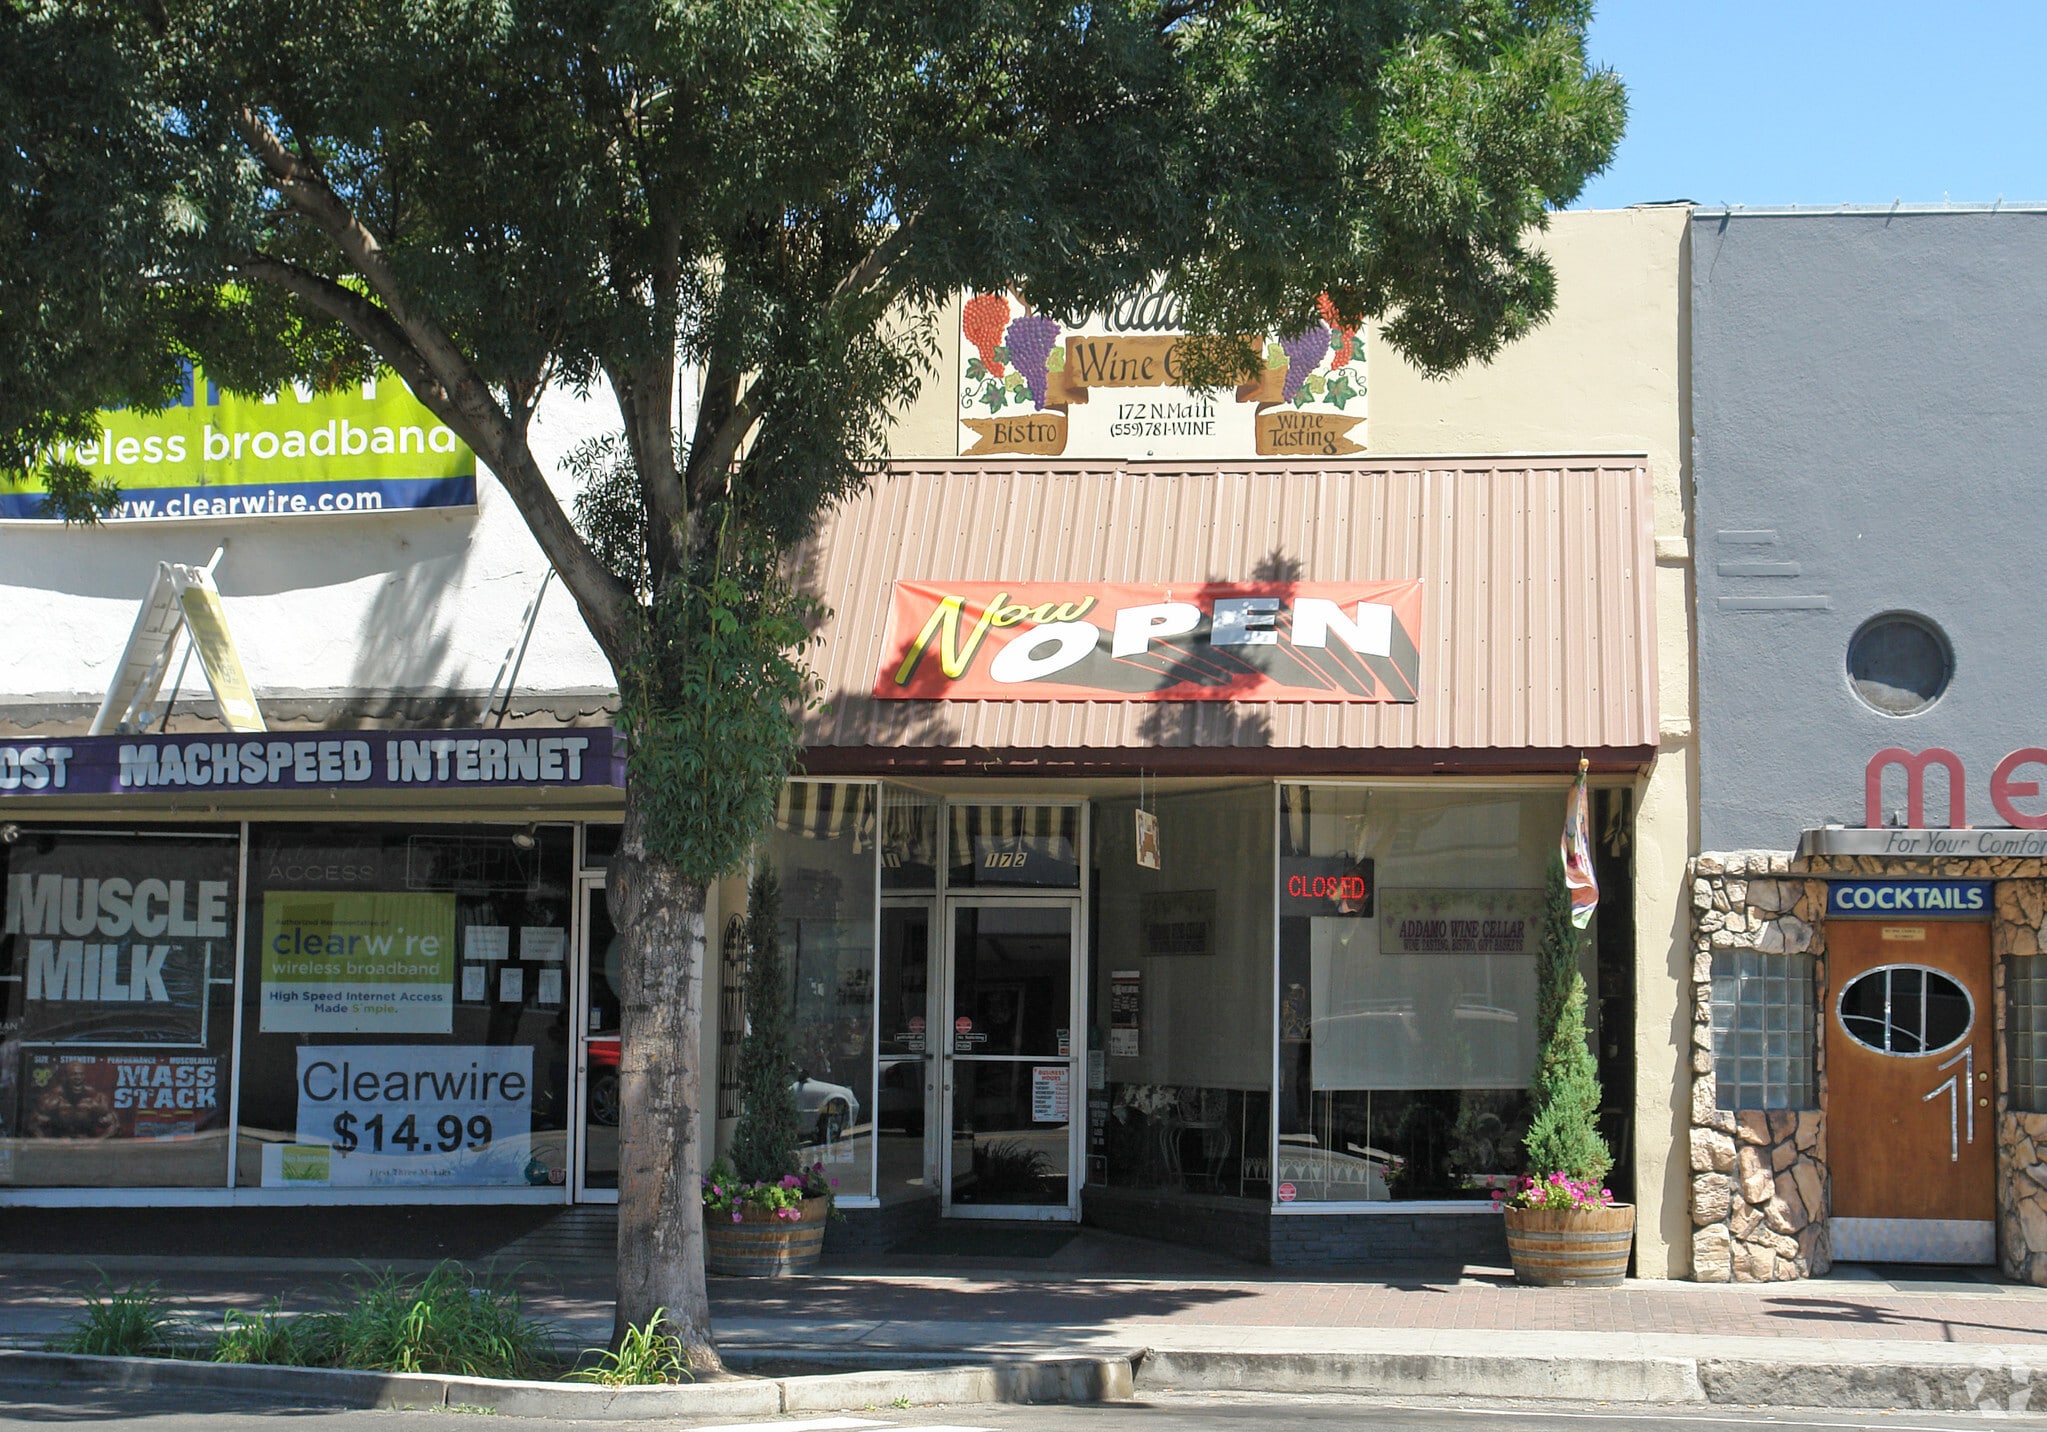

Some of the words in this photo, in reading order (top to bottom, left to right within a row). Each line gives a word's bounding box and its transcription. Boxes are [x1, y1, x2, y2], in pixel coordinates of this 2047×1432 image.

[1074, 342, 1154, 382] Wine
[1118, 403, 1147, 420] 172
[993, 422, 1058, 446] Bistro
[1268, 428, 1337, 455] Tasting
[92, 488, 383, 520] ww.clearwire.com
[895, 592, 1099, 686] Now
[988, 597, 1394, 684] OPEN
[119, 741, 373, 788] MACHSPEED
[387, 738, 590, 783] INTERNET
[1885, 831, 1920, 853] For
[1923, 831, 1970, 853] Your
[986, 852, 1027, 867] 172
[267, 864, 376, 882] ACCESS
[1288, 875, 1366, 899] CLOSED
[1835, 887, 1984, 910] COCKTAILS
[5, 874, 229, 937] MUSCLE
[1399, 919, 1447, 939] ADDAMO
[1450, 919, 1479, 938] WINE
[1482, 919, 1525, 938] CELLAR
[26, 939, 171, 1001] MILK
[271, 960, 341, 976] wireless
[346, 960, 440, 976] broadband
[269, 991, 299, 1004] High
[302, 991, 342, 1005] Speed
[346, 991, 396, 1002] Internet
[400, 991, 443, 1002] Access
[314, 1003, 348, 1013] Made
[34, 1055, 49, 1064] SIZE
[116, 1065, 217, 1087] MASS
[302, 1061, 527, 1102] Clearwire
[113, 1087, 217, 1109] STACK
[332, 1110, 494, 1158] $14.99
